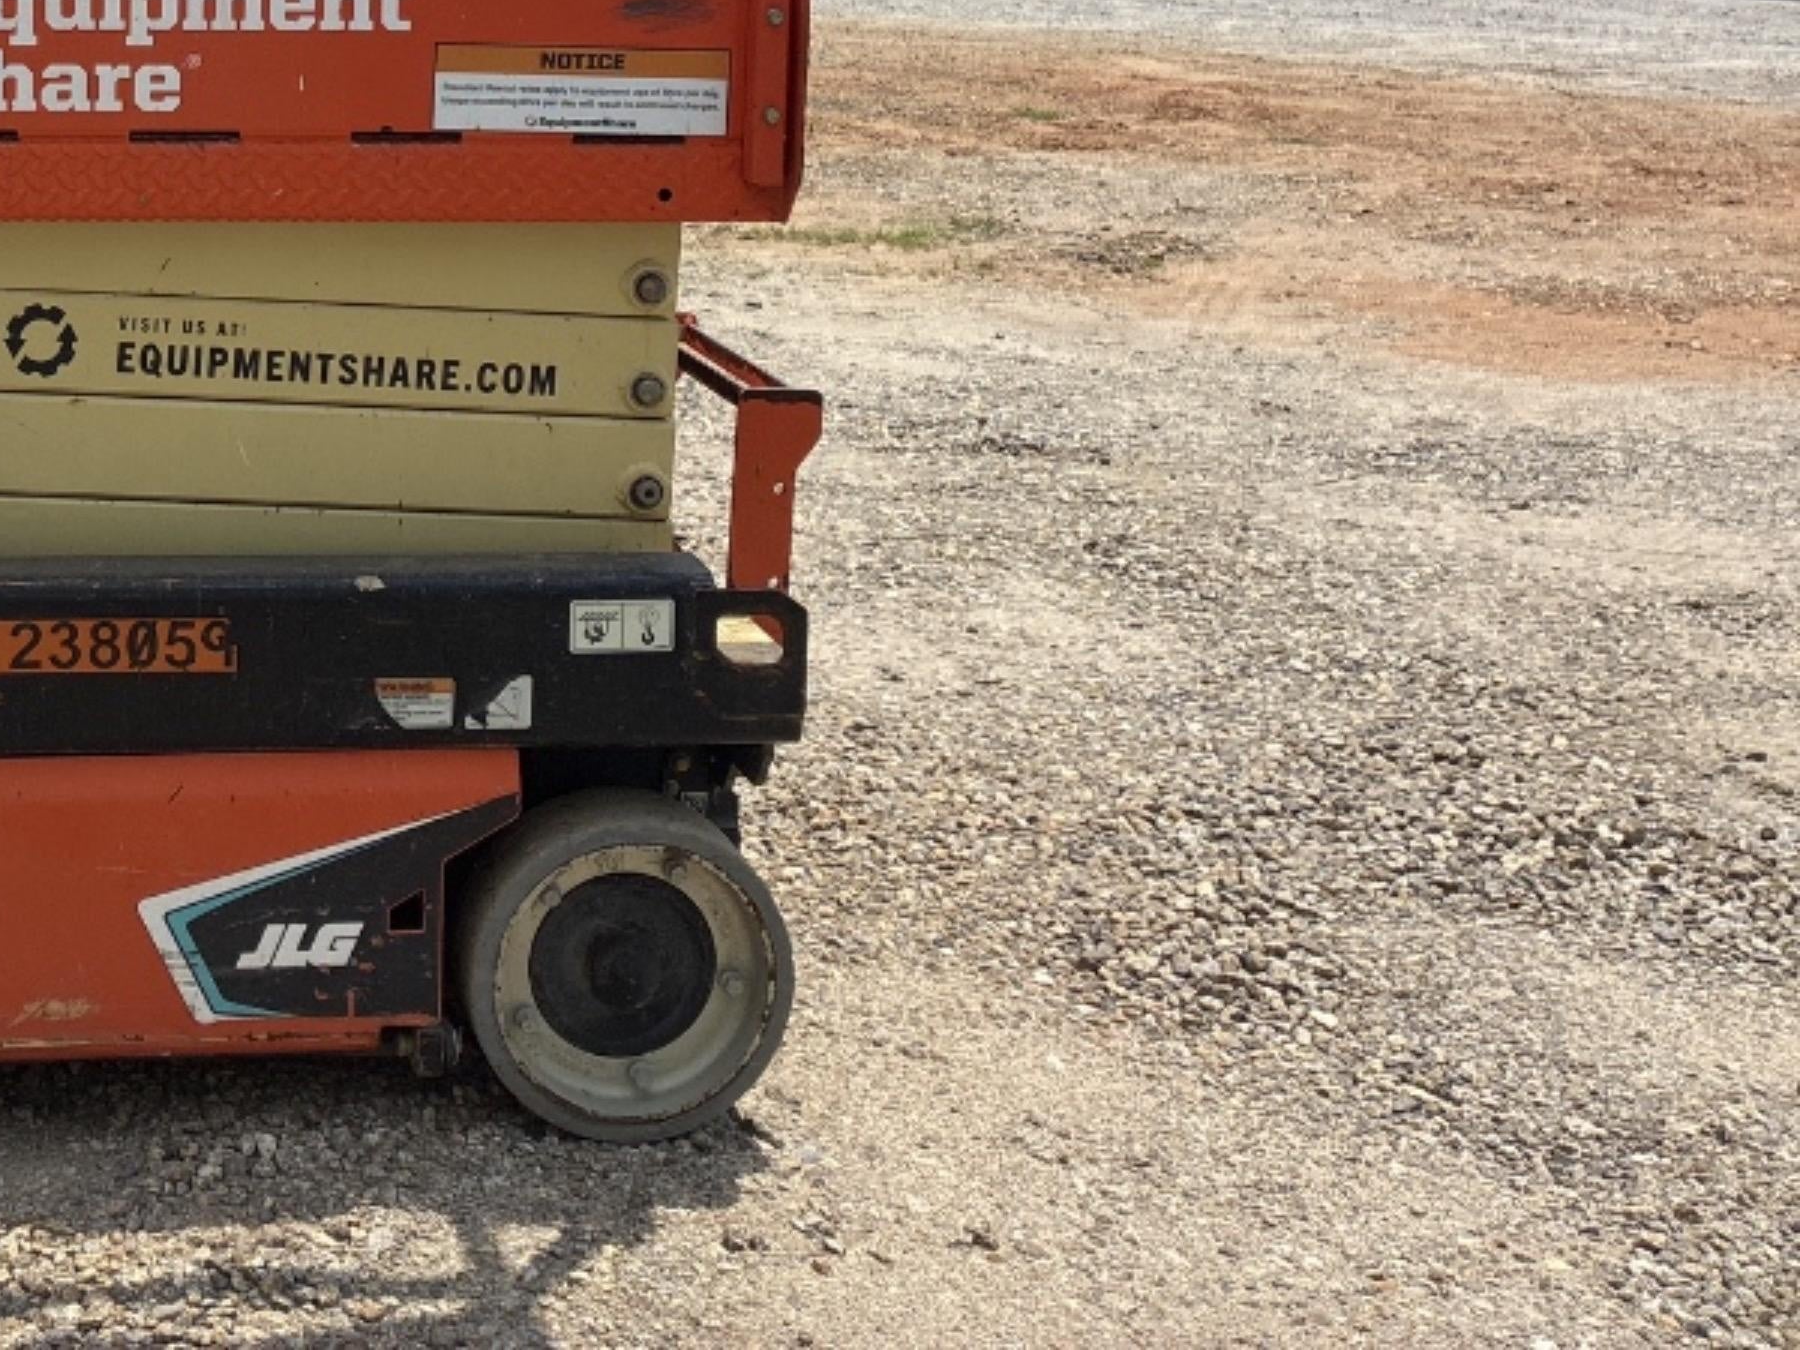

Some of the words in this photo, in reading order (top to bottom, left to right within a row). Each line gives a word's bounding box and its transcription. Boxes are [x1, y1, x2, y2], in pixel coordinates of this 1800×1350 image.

[540, 52, 626, 70] NOTICE
[119, 315, 171, 334] VISIT
[183, 319, 206, 335] US
[116, 341, 558, 397] EQUIPMENTSHARE.COM
[235, 922, 364, 970] JLG
